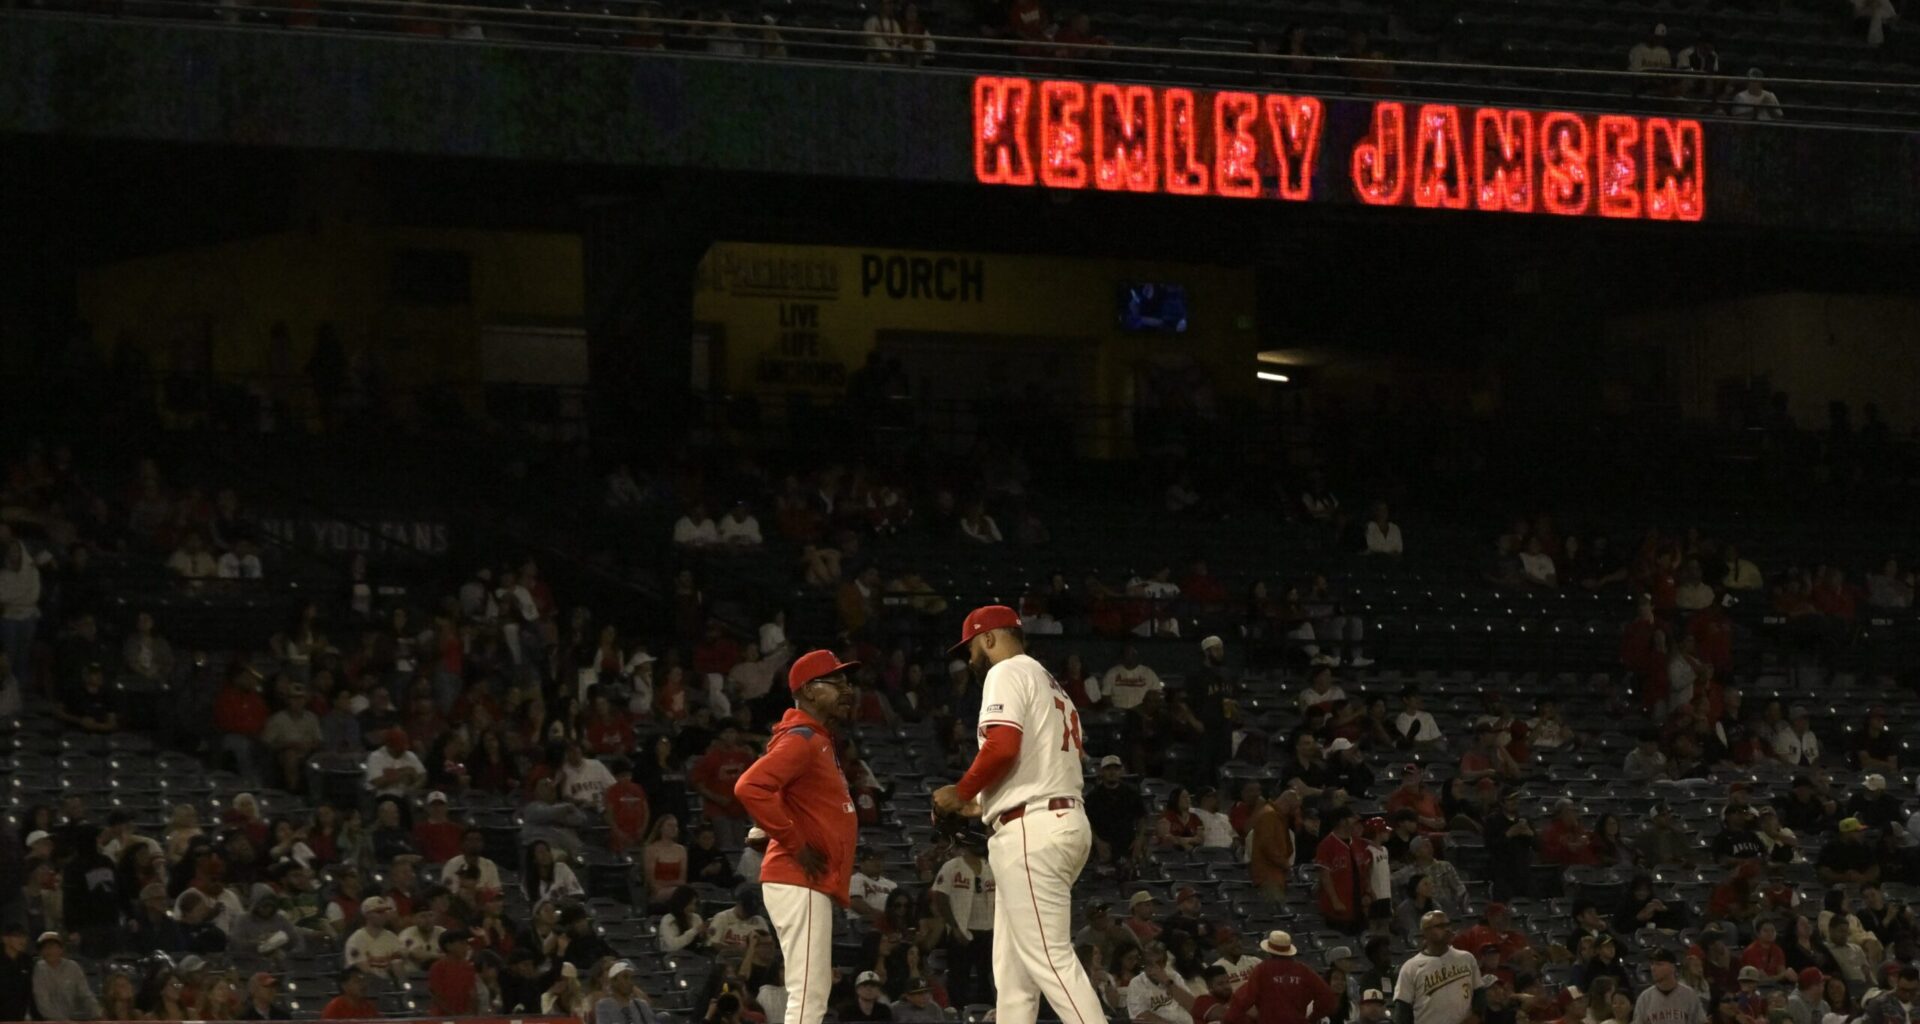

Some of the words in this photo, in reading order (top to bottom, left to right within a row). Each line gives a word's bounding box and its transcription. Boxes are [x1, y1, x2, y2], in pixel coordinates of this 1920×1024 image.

[972, 76, 1322, 201] KENLEY
[1350, 101, 1704, 221] JANSEN
[862, 255, 983, 301] PORCH
[780, 303, 819, 327] LIVE
[781, 331, 819, 356] LIFE
[1272, 975, 1301, 985] STFF
[1424, 964, 1471, 992] Athletics
